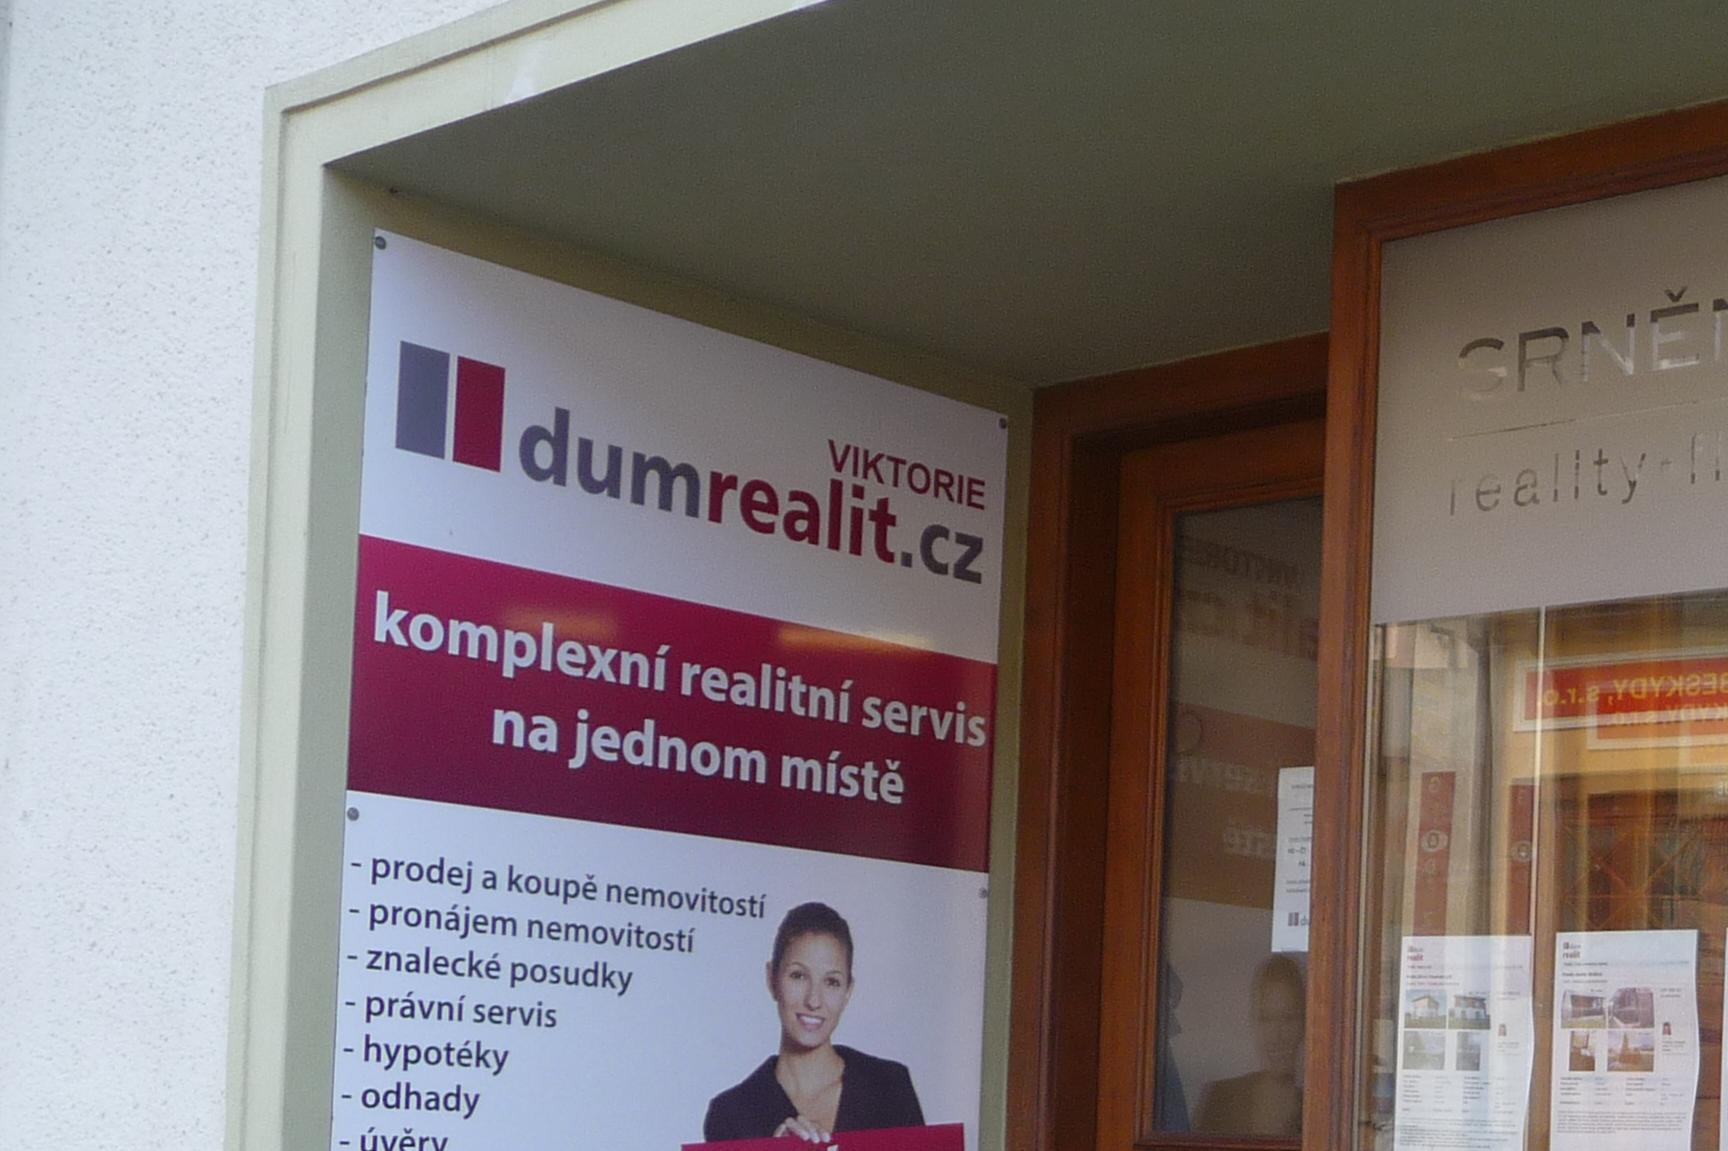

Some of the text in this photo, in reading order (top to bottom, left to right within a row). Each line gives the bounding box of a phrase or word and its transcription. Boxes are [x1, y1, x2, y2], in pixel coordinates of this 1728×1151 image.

[518, 406, 984, 585] dumrealit.cz
[827, 439, 986, 511] VIKTORIE
[374, 589, 986, 748] komplexní realitní servis
[492, 708, 905, 804] na jednom místě
[370, 856, 474, 895] prodej
[482, 869, 498, 890] a
[507, 865, 598, 905] koupě
[605, 885, 767, 919] nemovitostí
[369, 902, 517, 940] pronájem
[526, 917, 696, 953] nemovitostí
[366, 947, 501, 981] znalecké
[509, 961, 633, 997] posudky
[365, 992, 465, 1024] právní
[472, 1001, 558, 1028] servis
[363, 1034, 510, 1076] hypotéky
[361, 1082, 480, 1120] odhady
